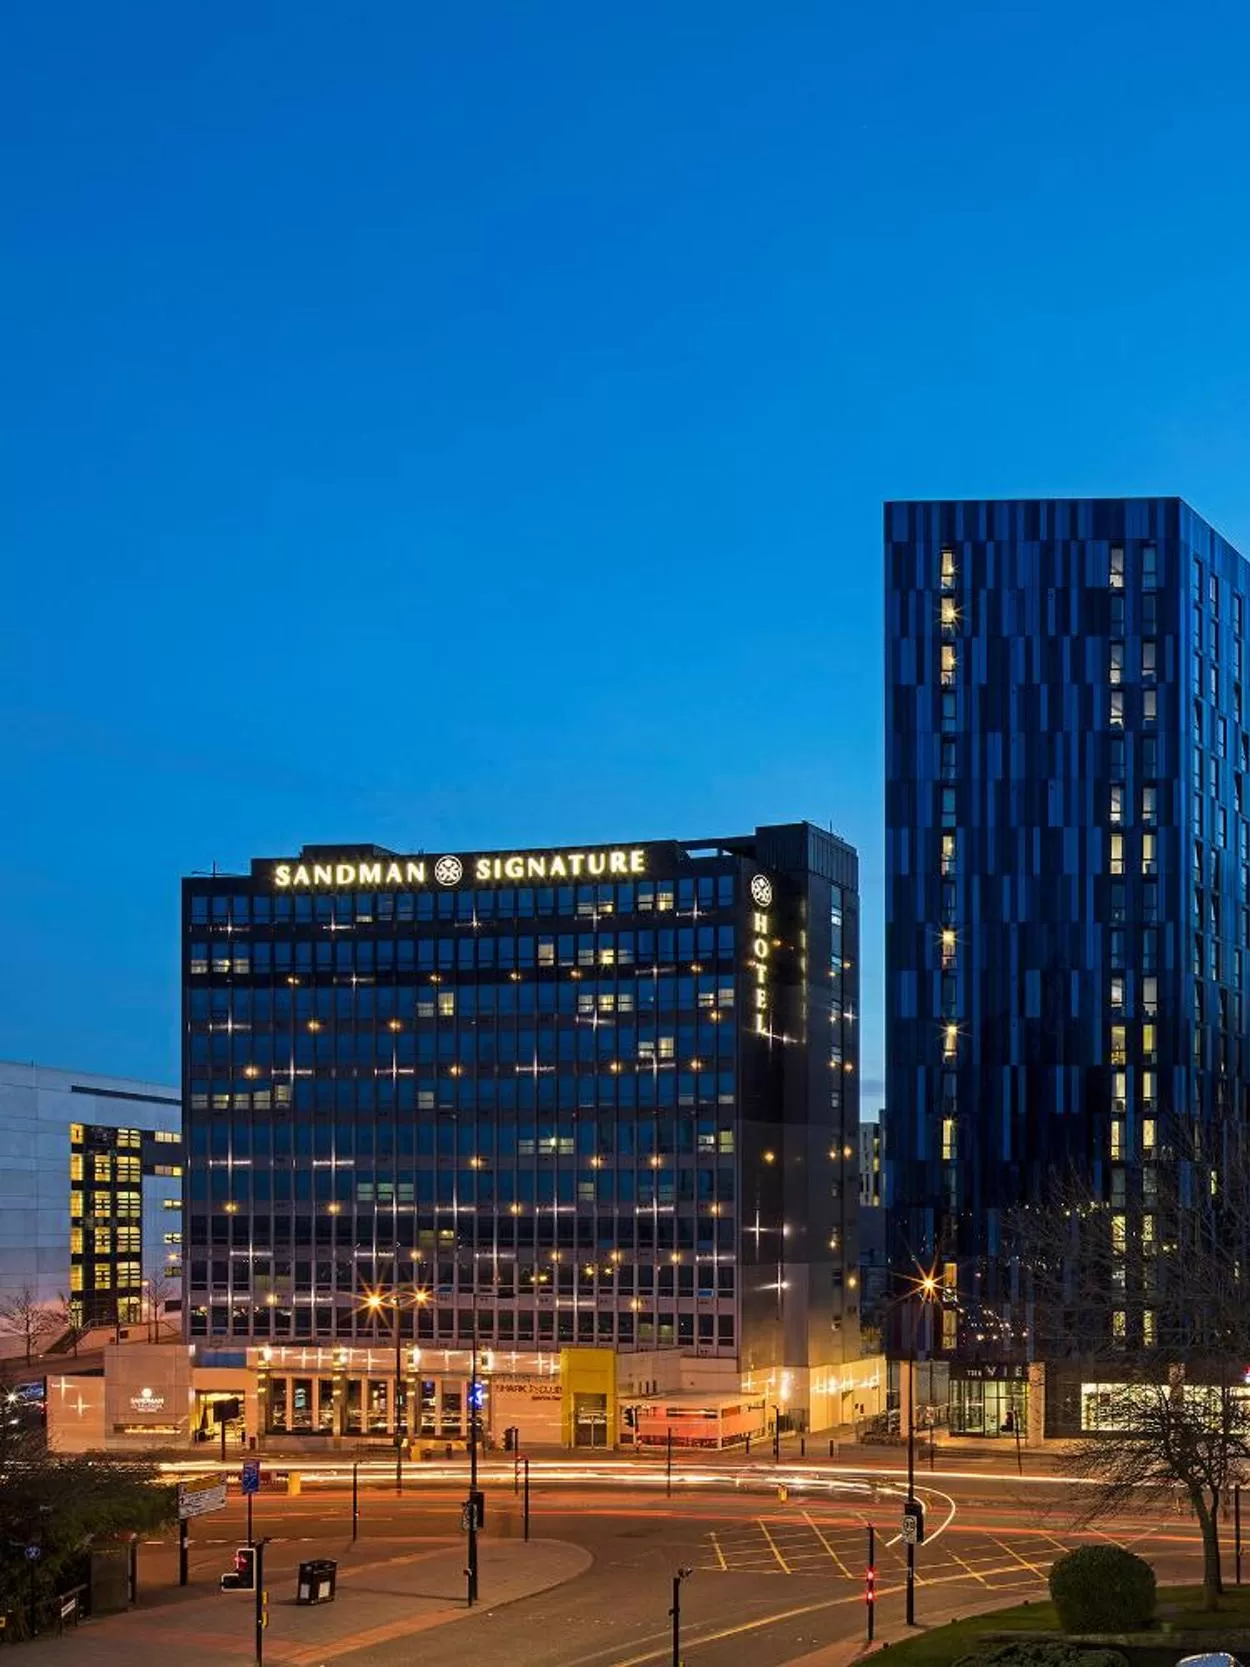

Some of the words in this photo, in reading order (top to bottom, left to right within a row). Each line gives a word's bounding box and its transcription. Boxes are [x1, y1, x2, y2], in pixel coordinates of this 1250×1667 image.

[274, 861, 426, 887] SANDMAN
[476, 849, 646, 880] SIGNATURE
[754, 912, 769, 1036] HOTEL
[985, 1365, 1023, 1377] VIE
